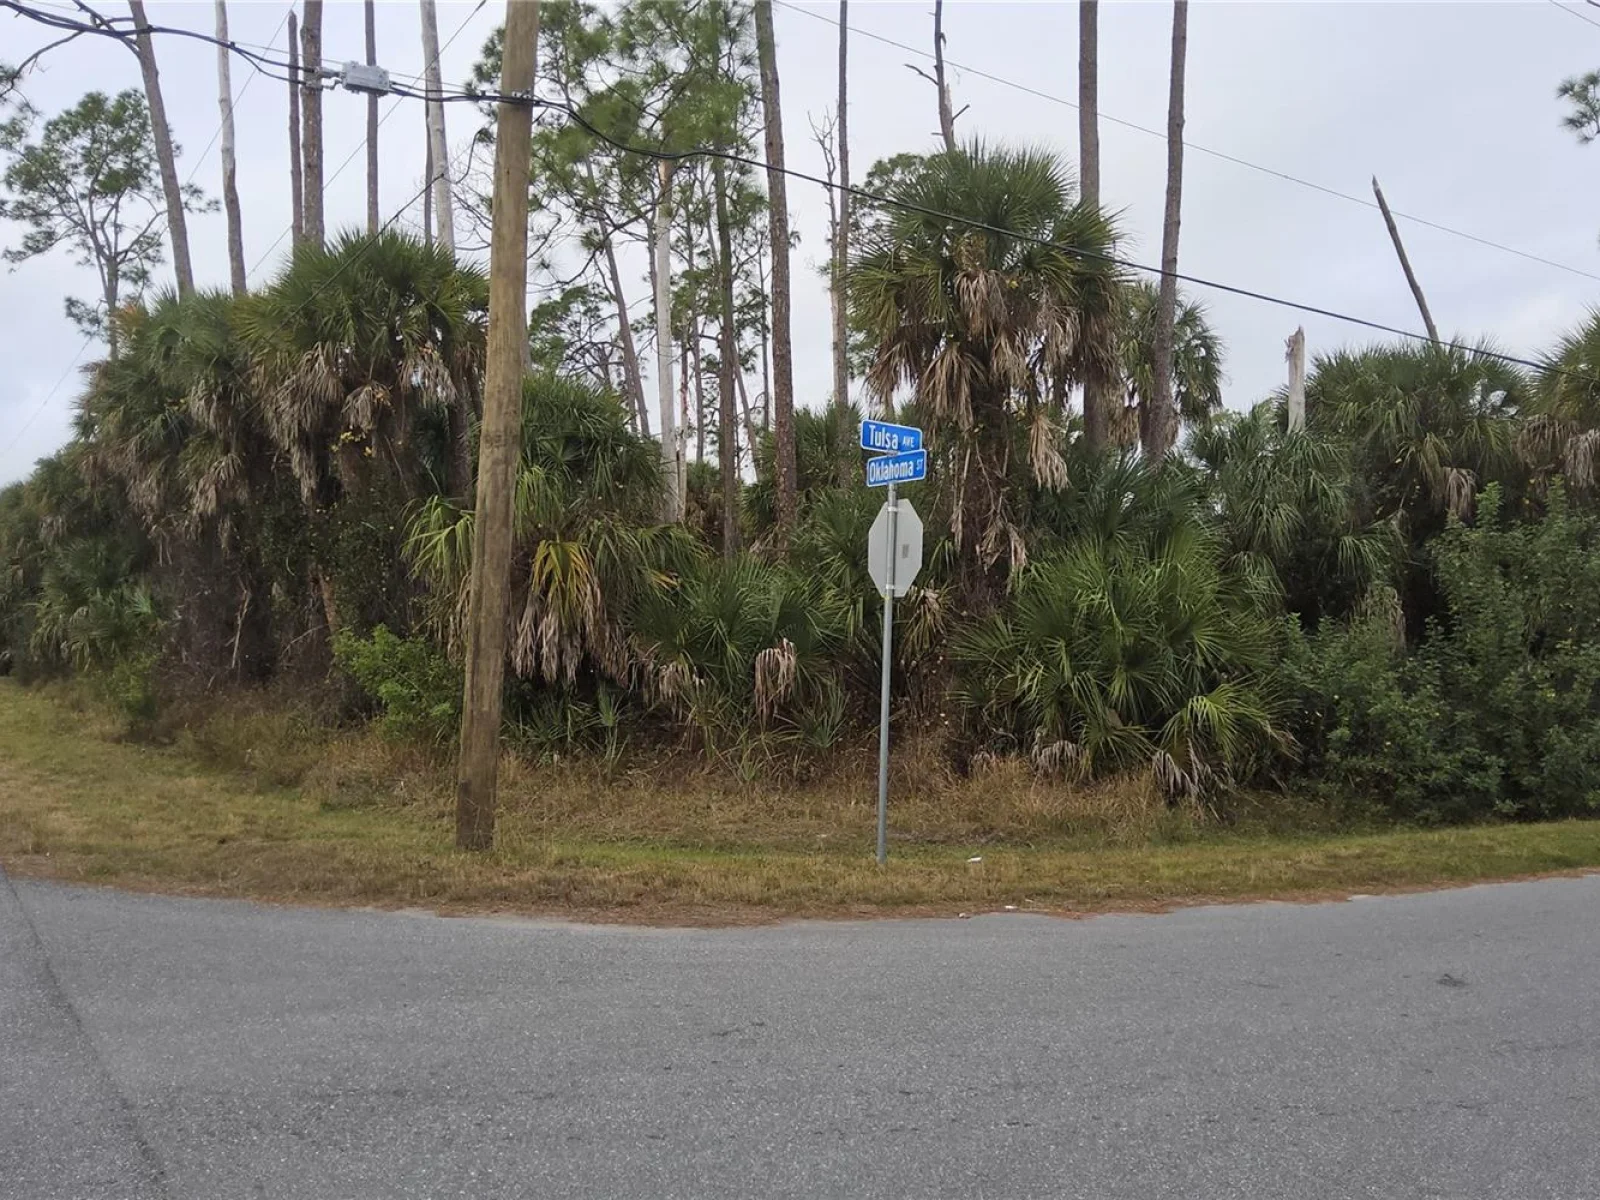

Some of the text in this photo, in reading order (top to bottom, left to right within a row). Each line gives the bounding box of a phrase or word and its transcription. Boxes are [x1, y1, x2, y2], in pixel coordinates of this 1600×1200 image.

[869, 425, 915, 449] Tulsa AVE
[869, 459, 924, 482] Oklahoma ST
